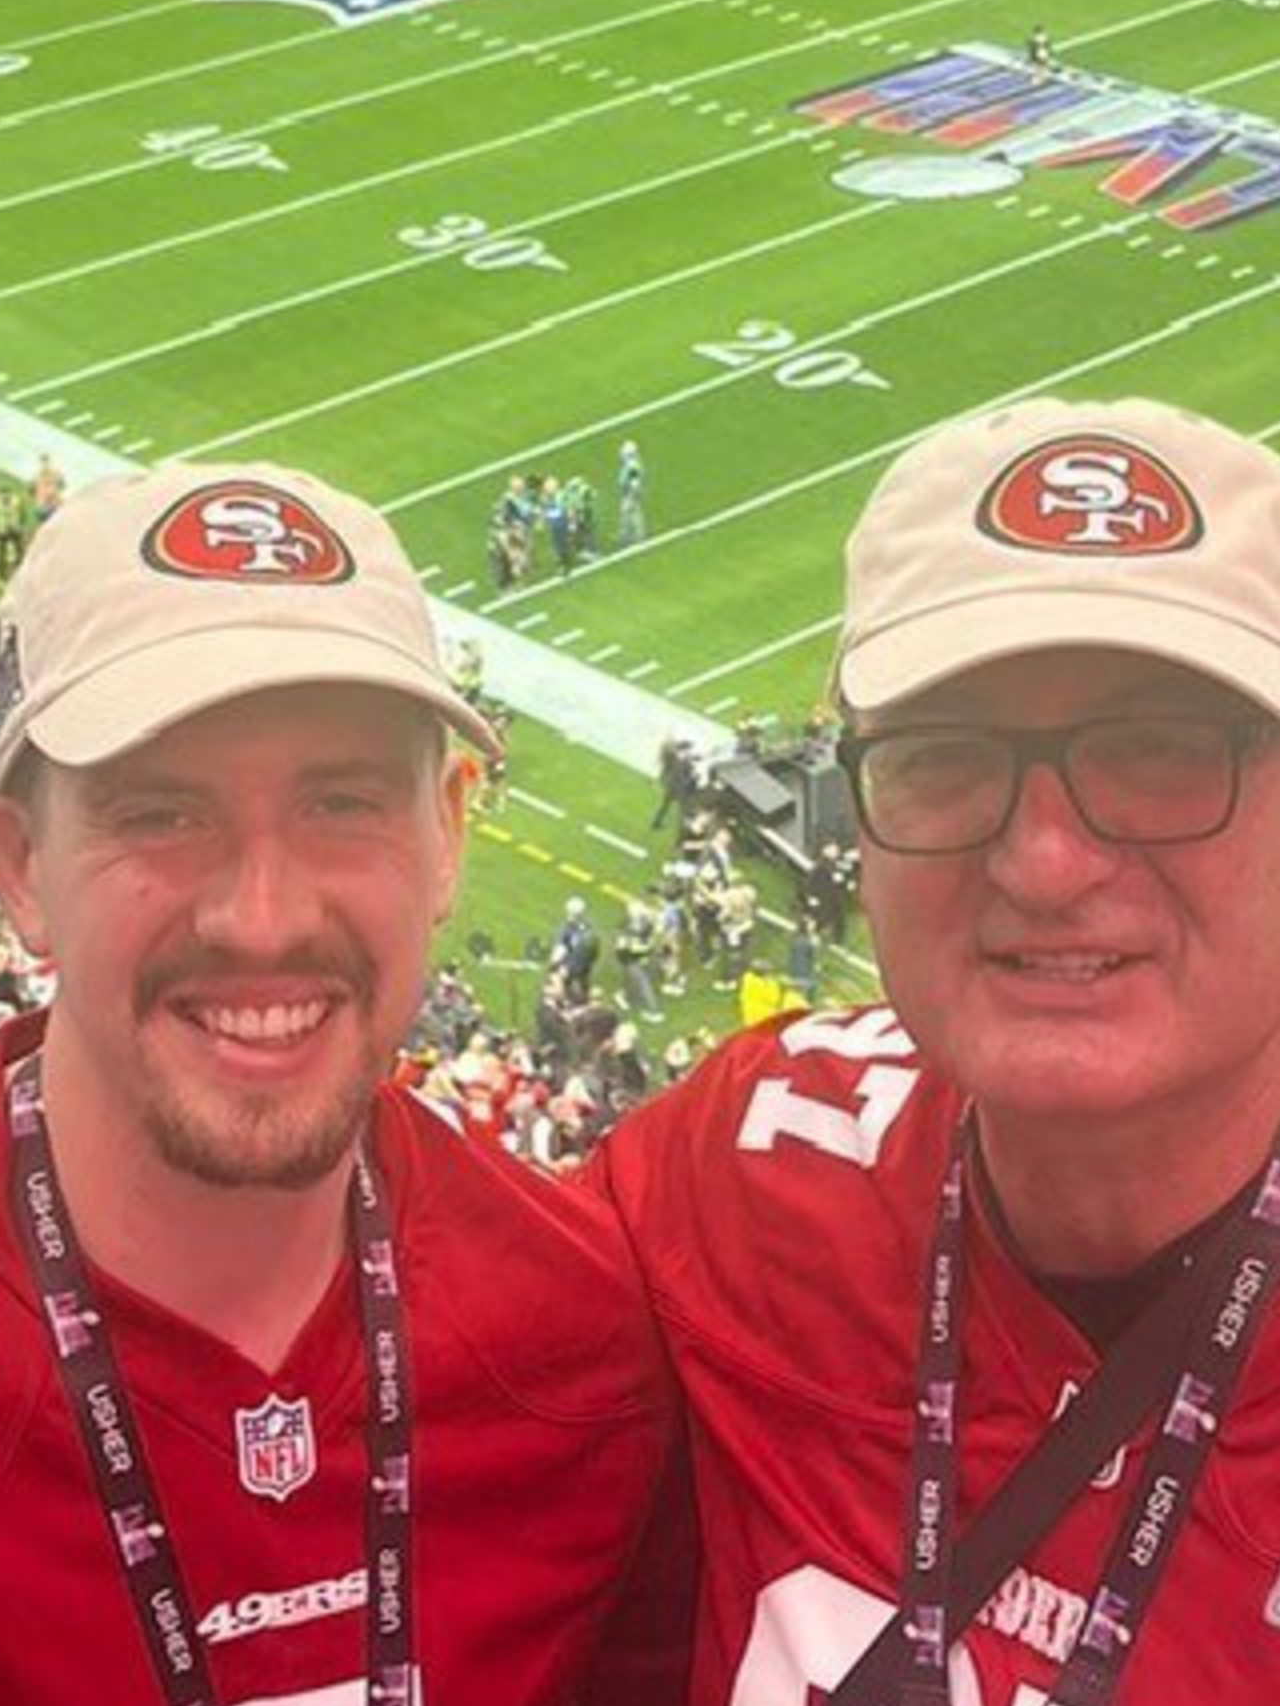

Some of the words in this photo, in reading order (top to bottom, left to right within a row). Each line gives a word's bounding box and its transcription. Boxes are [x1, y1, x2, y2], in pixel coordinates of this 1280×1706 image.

[692, 319, 860, 389] 20
[25, 1170, 65, 1261] USHER
[931, 1254, 953, 1344] USHER
[1212, 1257, 1266, 1349] USHER
[374, 1330, 400, 1424] USHER
[86, 1382, 134, 1476] USHER
[253, 1438, 303, 1479] NFL
[916, 1478, 941, 1570] USHER
[1133, 1475, 1181, 1567] USHER
[150, 1588, 194, 1675] USHER
[377, 1548, 402, 1634] USHER
